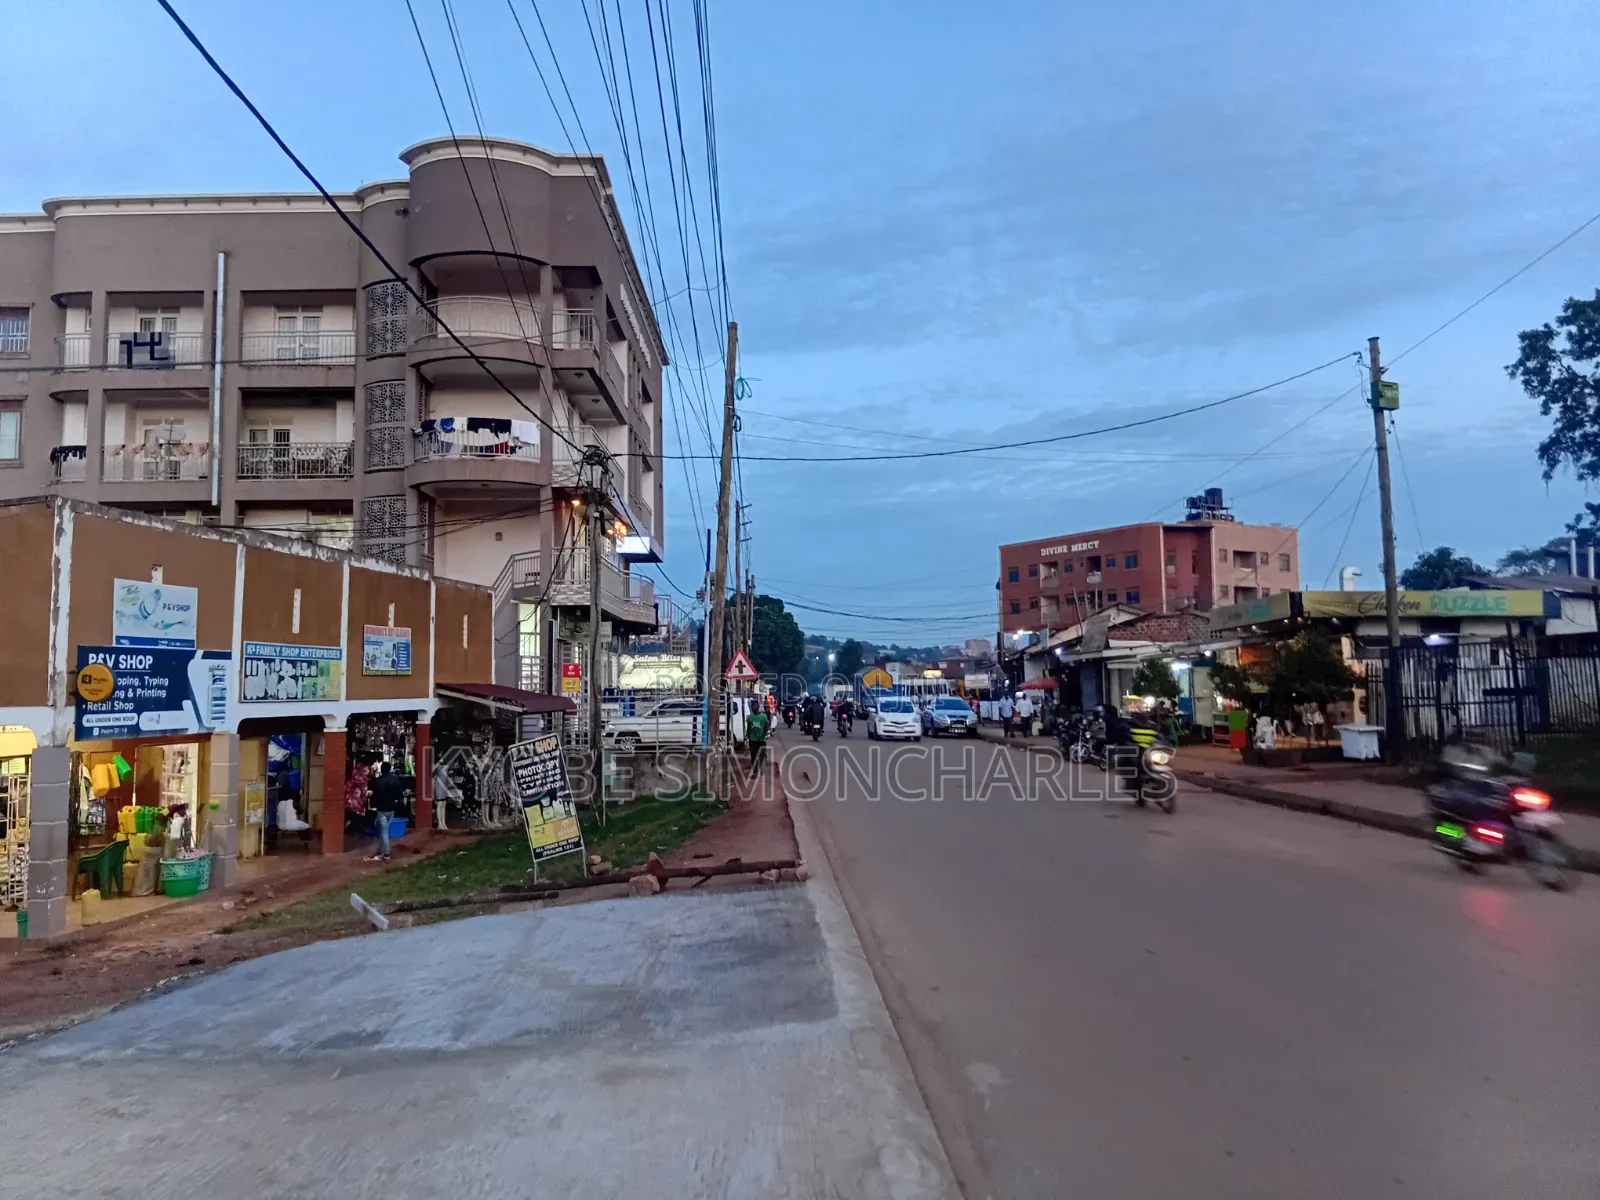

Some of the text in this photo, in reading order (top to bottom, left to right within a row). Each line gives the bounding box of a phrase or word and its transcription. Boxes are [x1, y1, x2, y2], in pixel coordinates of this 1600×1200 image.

[1040, 540, 1100, 557] DIVINE MERCY
[1357, 592, 1508, 614] Chiken PUZZLE
[256, 645, 280, 657] FAMILY
[281, 646, 300, 657] SHOP
[300, 647, 341, 659] ENTERPRISES
[633, 653, 682, 662] Salon Bliss
[118, 654, 154, 670] SHOP
[144, 675, 169, 687] Typing
[127, 688, 134, 698] &
[136, 687, 167, 699] Printing
[87, 701, 135, 712] Retail Shop
[535, 736, 558, 754] SHOP
[517, 758, 560, 778] PHOTOCOPY
[519, 768, 561, 784] PRINTING
[521, 774, 561, 789] TYPING
[523, 780, 565, 797] LAMINATION
